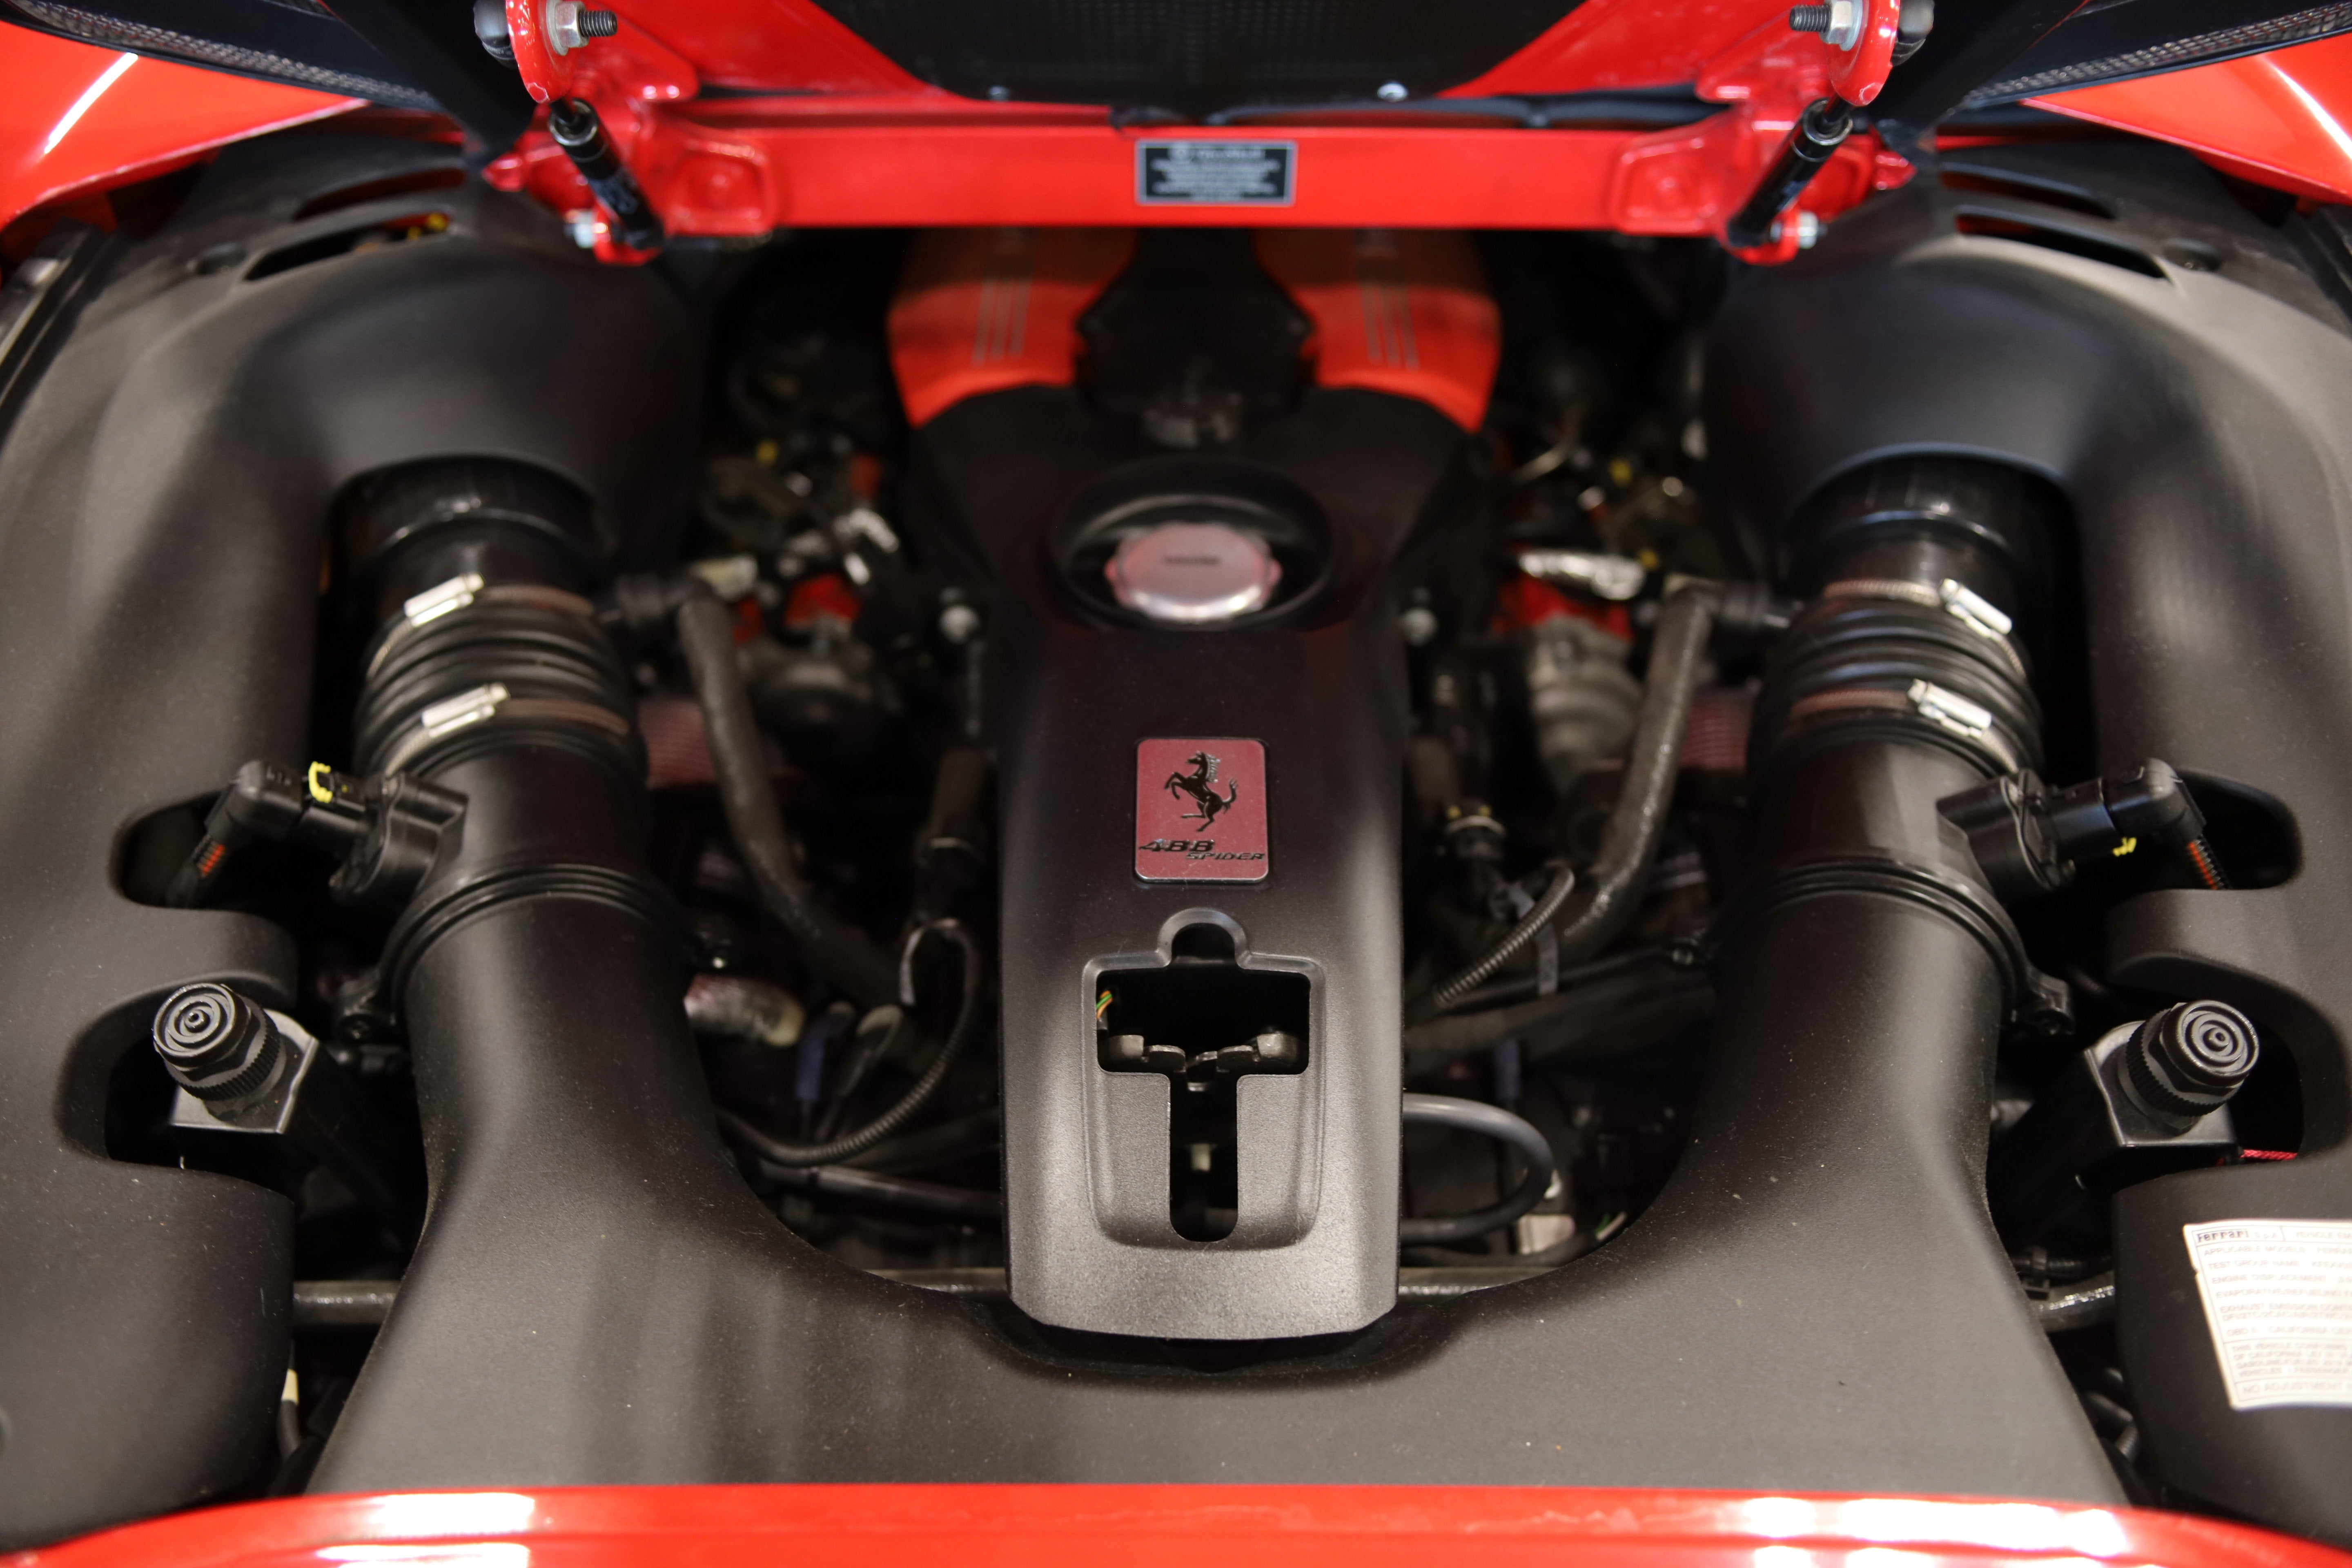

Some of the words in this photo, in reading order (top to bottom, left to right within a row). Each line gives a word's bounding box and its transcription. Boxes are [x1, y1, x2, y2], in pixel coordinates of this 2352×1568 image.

[1139, 839, 1215, 852] 488
[1185, 852, 1265, 860] SPIDER
[2197, 1229, 2248, 1243] Ferrari
[2204, 1245, 2261, 1256] APPLICABLE
[2207, 1261, 2230, 1270] TEST
[2212, 1274, 2247, 1284] ENGINE
[2220, 1303, 2265, 1313] EXHAUST
[2227, 1327, 2248, 1337] OBD
[2243, 1384, 2260, 1394] NO
